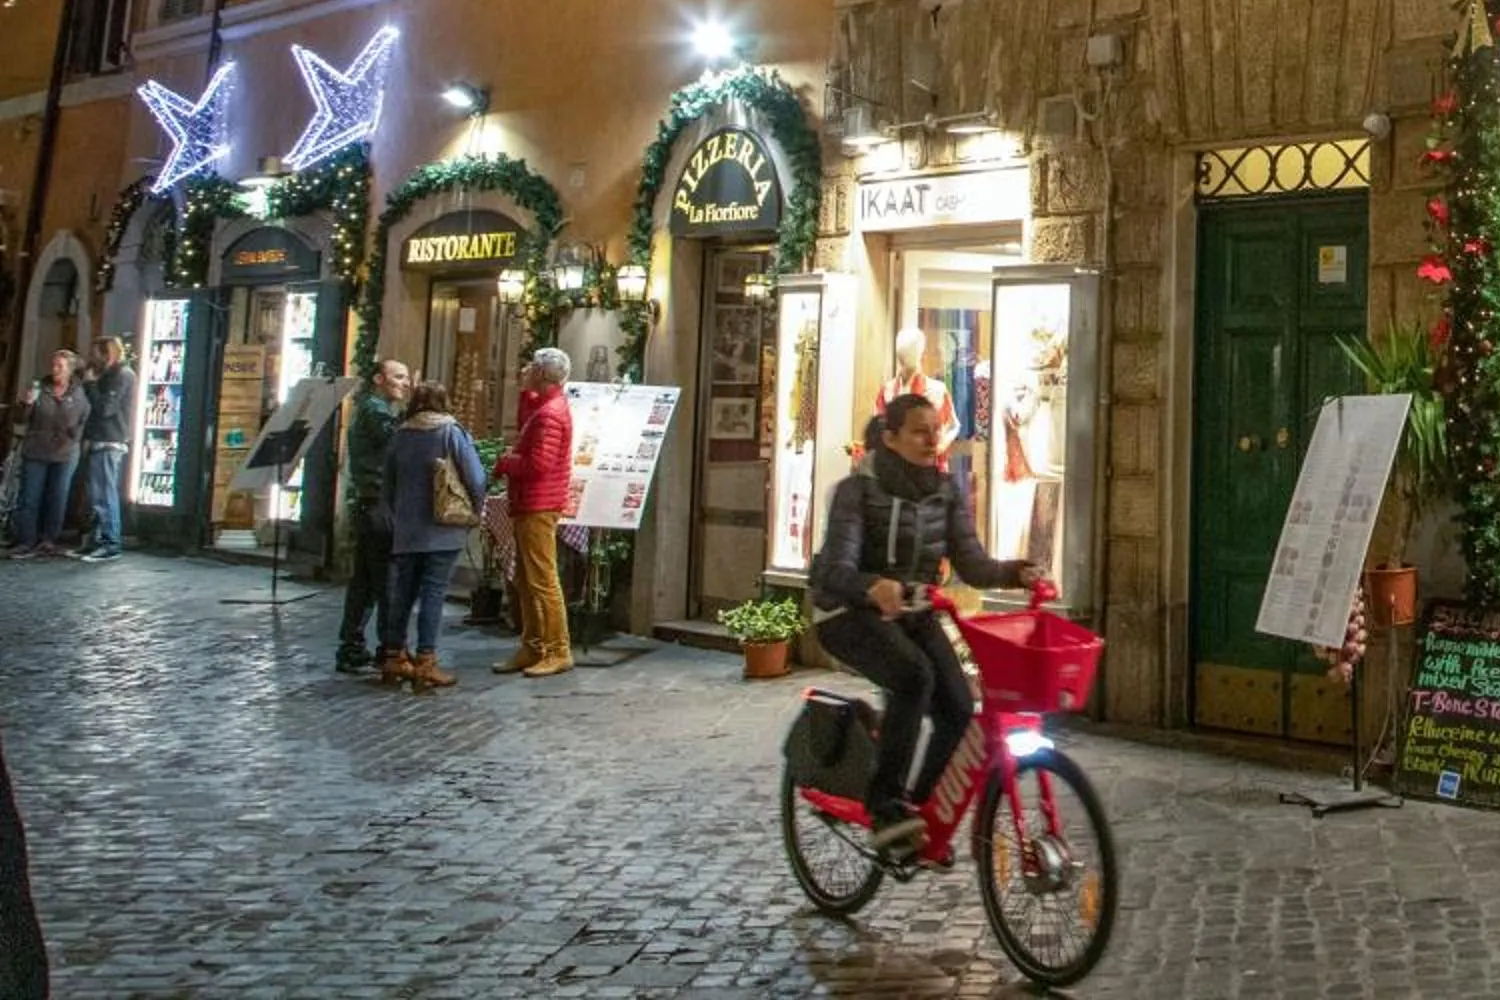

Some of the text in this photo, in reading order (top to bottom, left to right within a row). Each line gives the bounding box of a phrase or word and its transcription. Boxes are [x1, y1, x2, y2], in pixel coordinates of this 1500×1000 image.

[674, 132, 772, 214] PIZZERIA
[689, 201, 758, 223] La Fiorfiore
[861, 184, 931, 220] IKAAT
[407, 231, 517, 262] RISTORANTE
